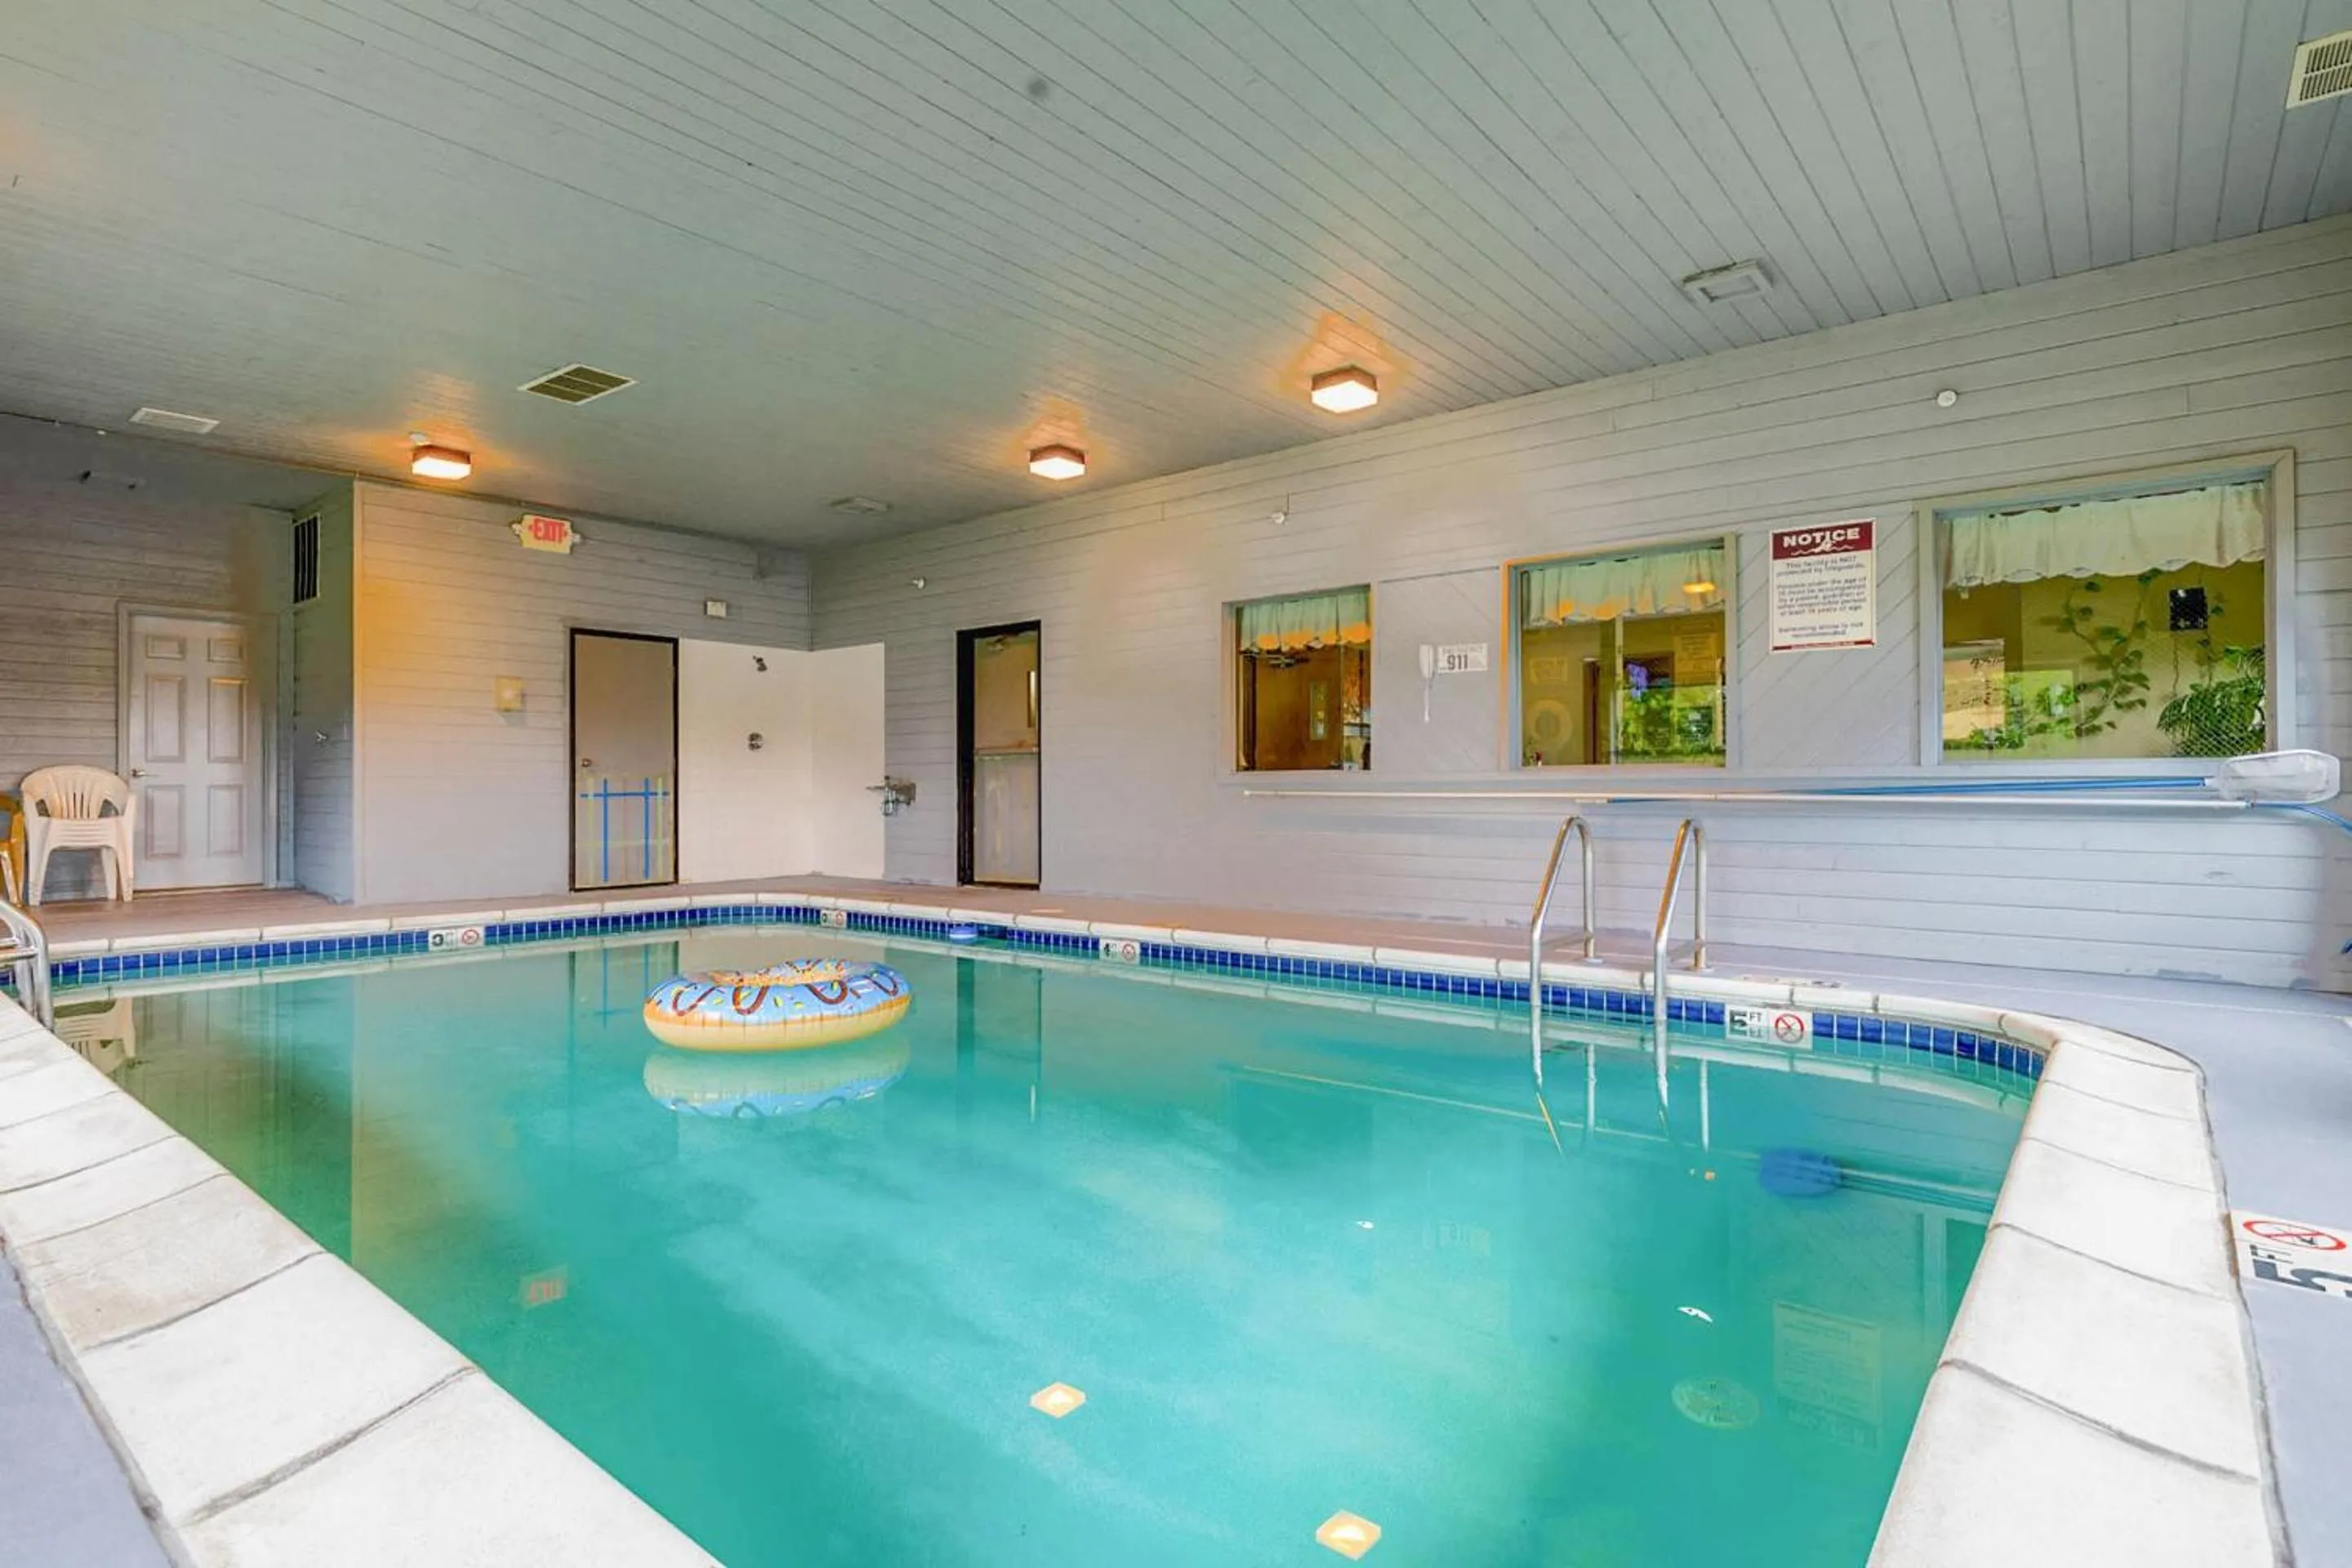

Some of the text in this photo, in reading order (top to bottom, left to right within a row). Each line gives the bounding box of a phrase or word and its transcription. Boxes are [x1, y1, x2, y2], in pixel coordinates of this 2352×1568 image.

[1783, 528, 1860, 548] NOTICE
[1446, 653, 1468, 670] 911
[1730, 1009, 1762, 1036] 5 FT
